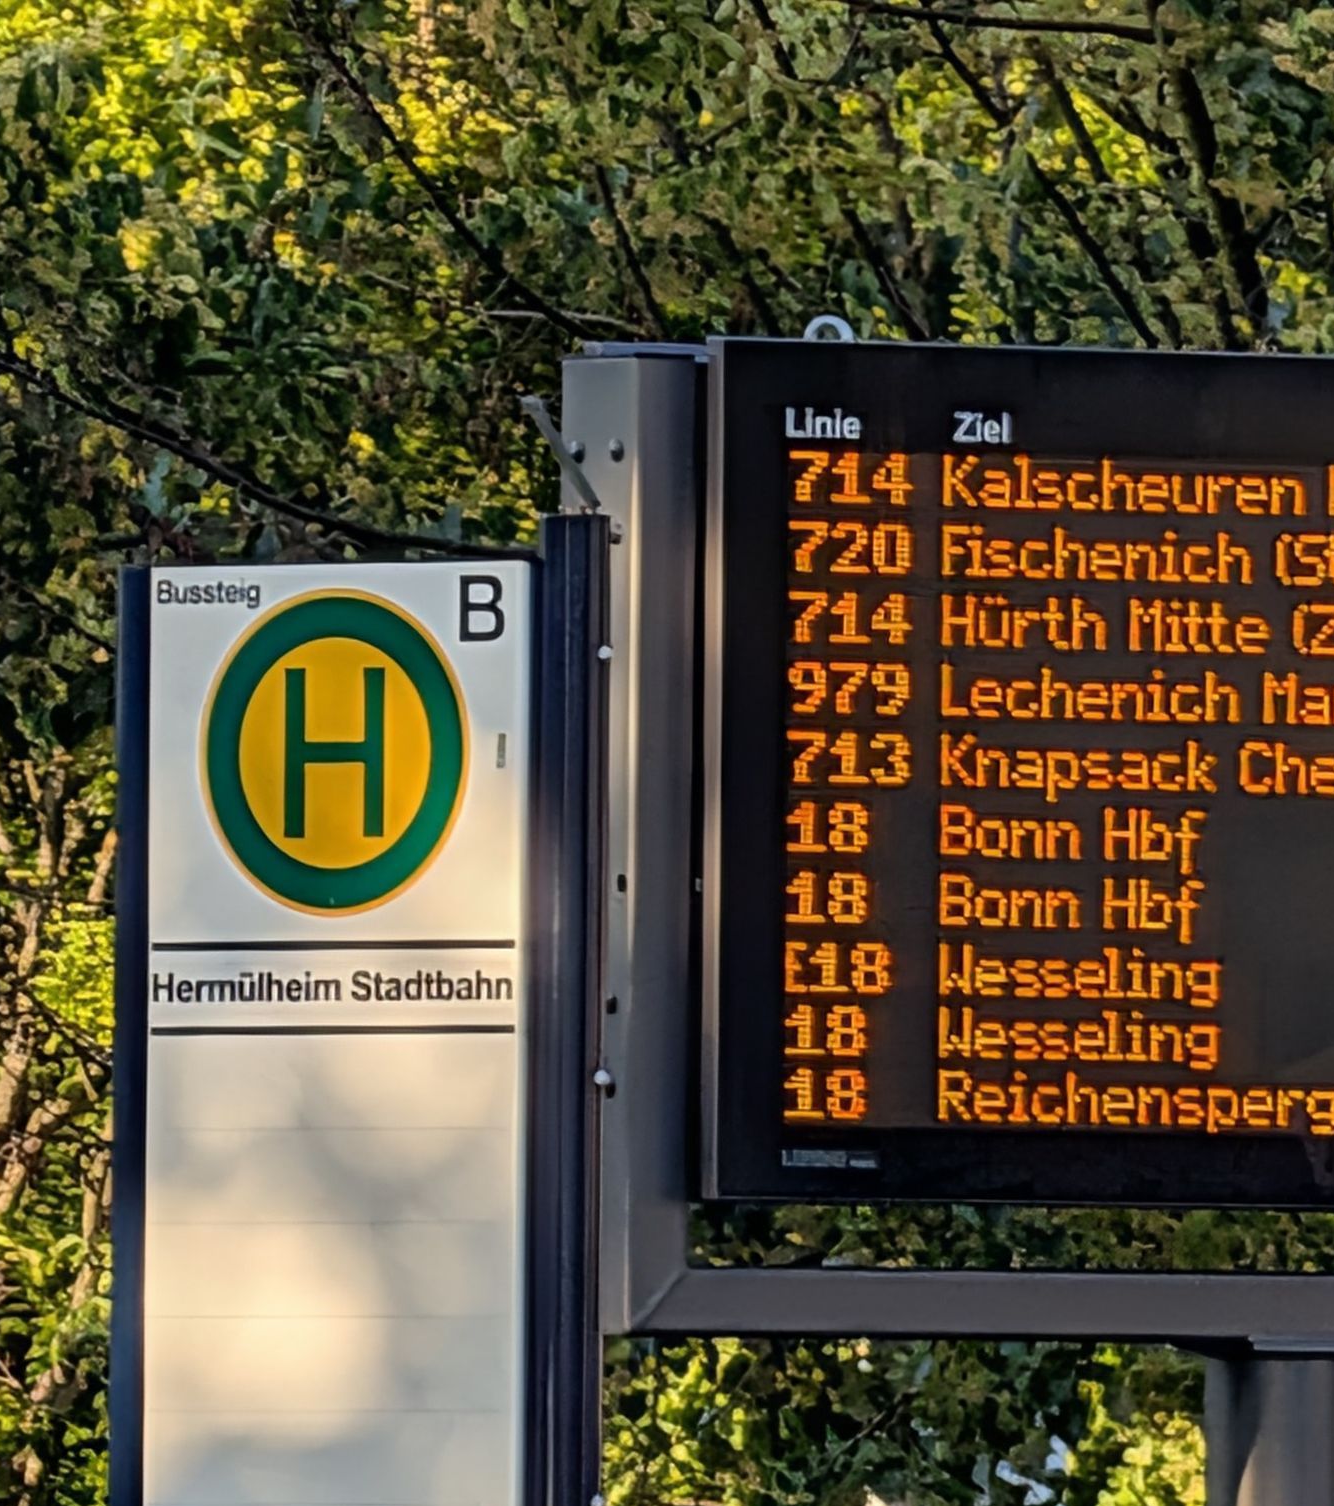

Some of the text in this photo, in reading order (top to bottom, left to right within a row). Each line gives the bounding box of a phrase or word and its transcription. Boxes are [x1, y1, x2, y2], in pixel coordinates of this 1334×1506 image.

[786, 407, 861, 439] Linie
[953, 412, 1010, 444] Ziel
[789, 450, 914, 505] 714
[942, 454, 1306, 516] Kalscheuren
[789, 520, 912, 575] 720
[941, 524, 1252, 584] Fischenich
[157, 579, 261, 608] Bussteig
[459, 574, 505, 643] B
[788, 591, 912, 644] 714
[941, 594, 1106, 651] Hürth
[1129, 598, 1270, 654] Mitte
[788, 661, 910, 716] 979
[941, 663, 1240, 723] Lechenich
[284, 667, 385, 838] H
[786, 730, 911, 784] 713
[940, 733, 1217, 803] Knapsack
[786, 801, 869, 853] 18
[940, 803, 1081, 860] Bonn
[1104, 807, 1206, 875] Hbf
[785, 871, 868, 924] 18
[939, 873, 1081, 929] Bonn
[1103, 876, 1205, 944] Hbf
[152, 970, 511, 1003] Hermülheim Stadtbahn
[784, 941, 892, 994] E18
[939, 943, 1221, 1009] Wesseling
[784, 1004, 867, 1057] 18
[938, 1006, 1220, 1071] Wesseling
[784, 1067, 866, 1119] 18
